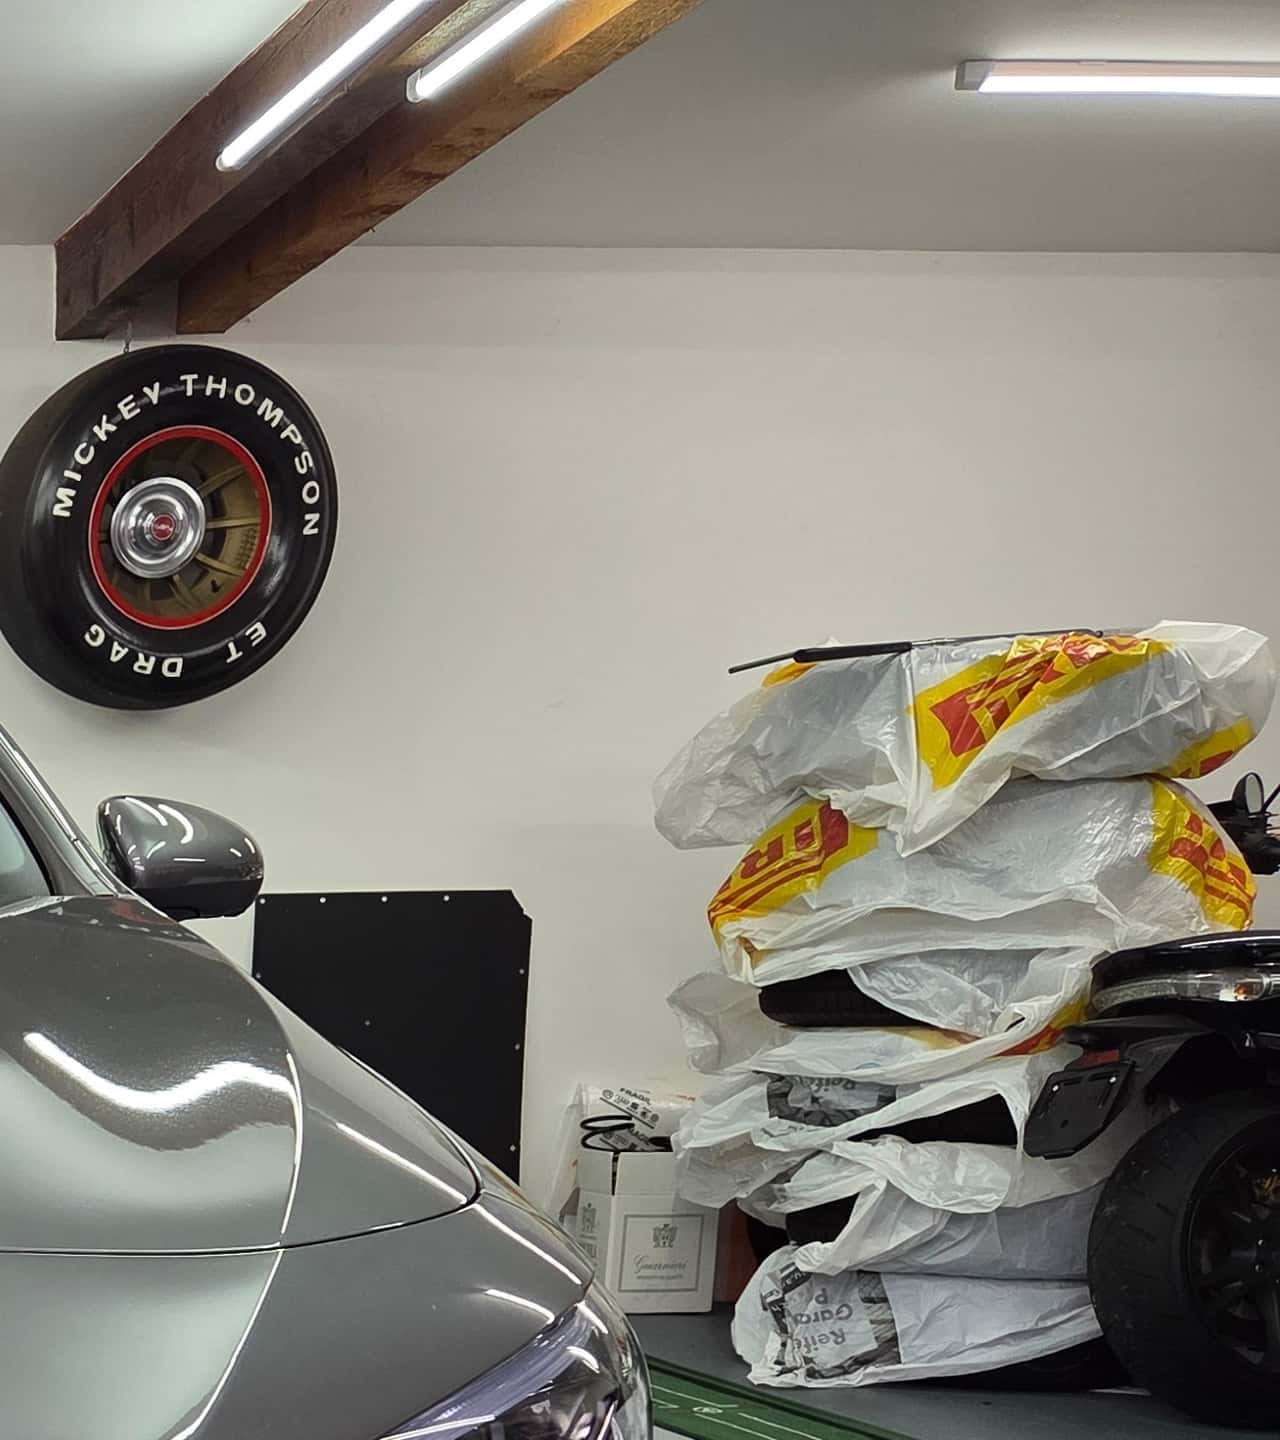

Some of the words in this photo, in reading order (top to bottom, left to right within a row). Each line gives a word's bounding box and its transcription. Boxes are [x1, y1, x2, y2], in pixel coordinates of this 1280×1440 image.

[52, 381, 161, 518] MICKEY
[180, 373, 320, 535] THOMPSON
[84, 623, 183, 678] DRAG
[226, 621, 267, 664] ET
